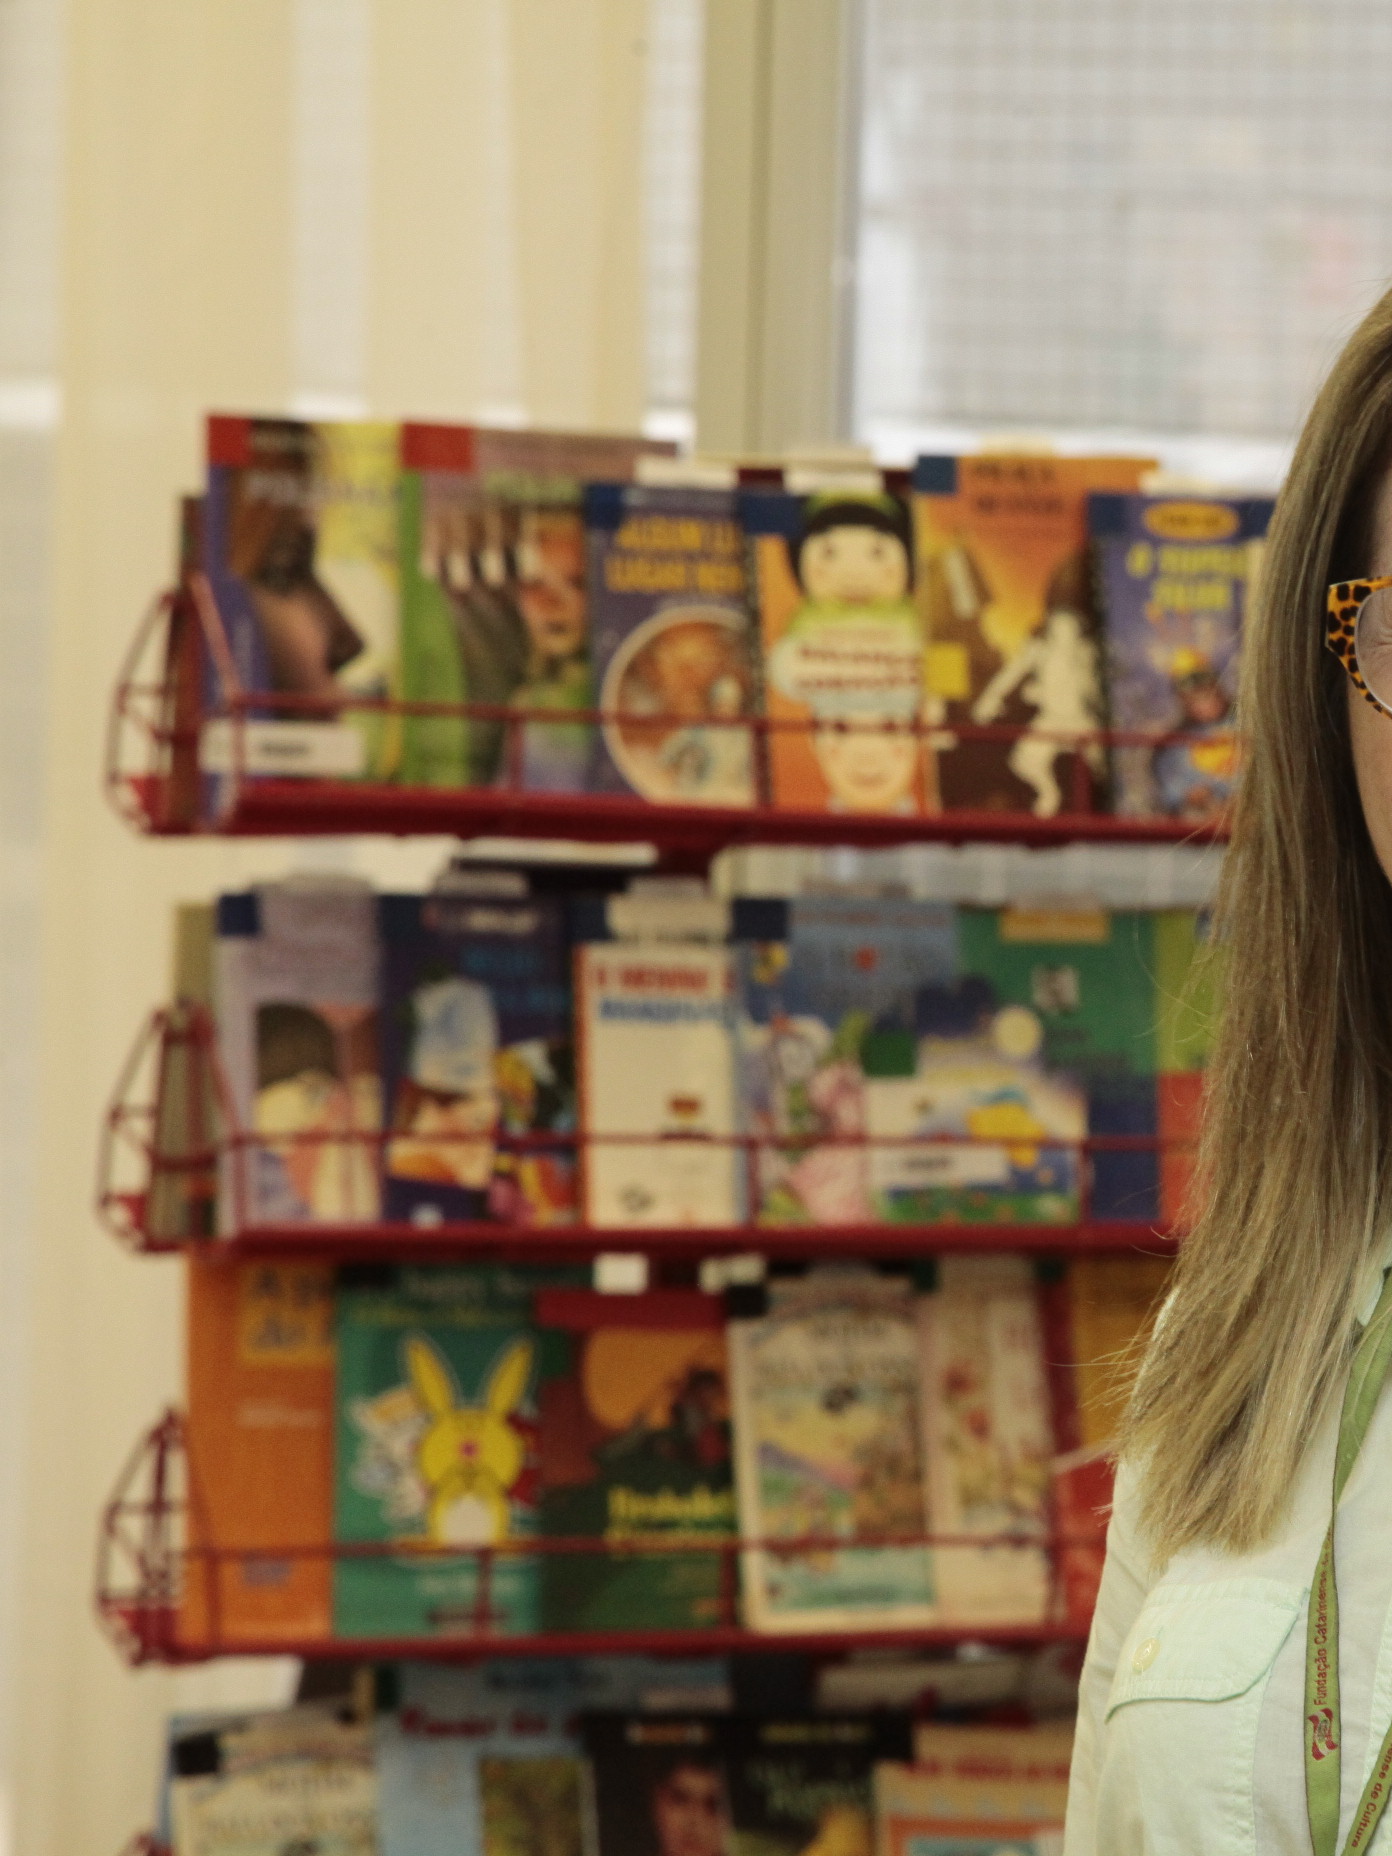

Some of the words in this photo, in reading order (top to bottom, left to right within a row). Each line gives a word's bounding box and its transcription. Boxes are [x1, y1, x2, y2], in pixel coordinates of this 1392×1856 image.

[1313, 1648, 1331, 1706] Fundação
[1370, 1782, 1384, 1801] de
[1351, 1802, 1377, 1848] Cultura
